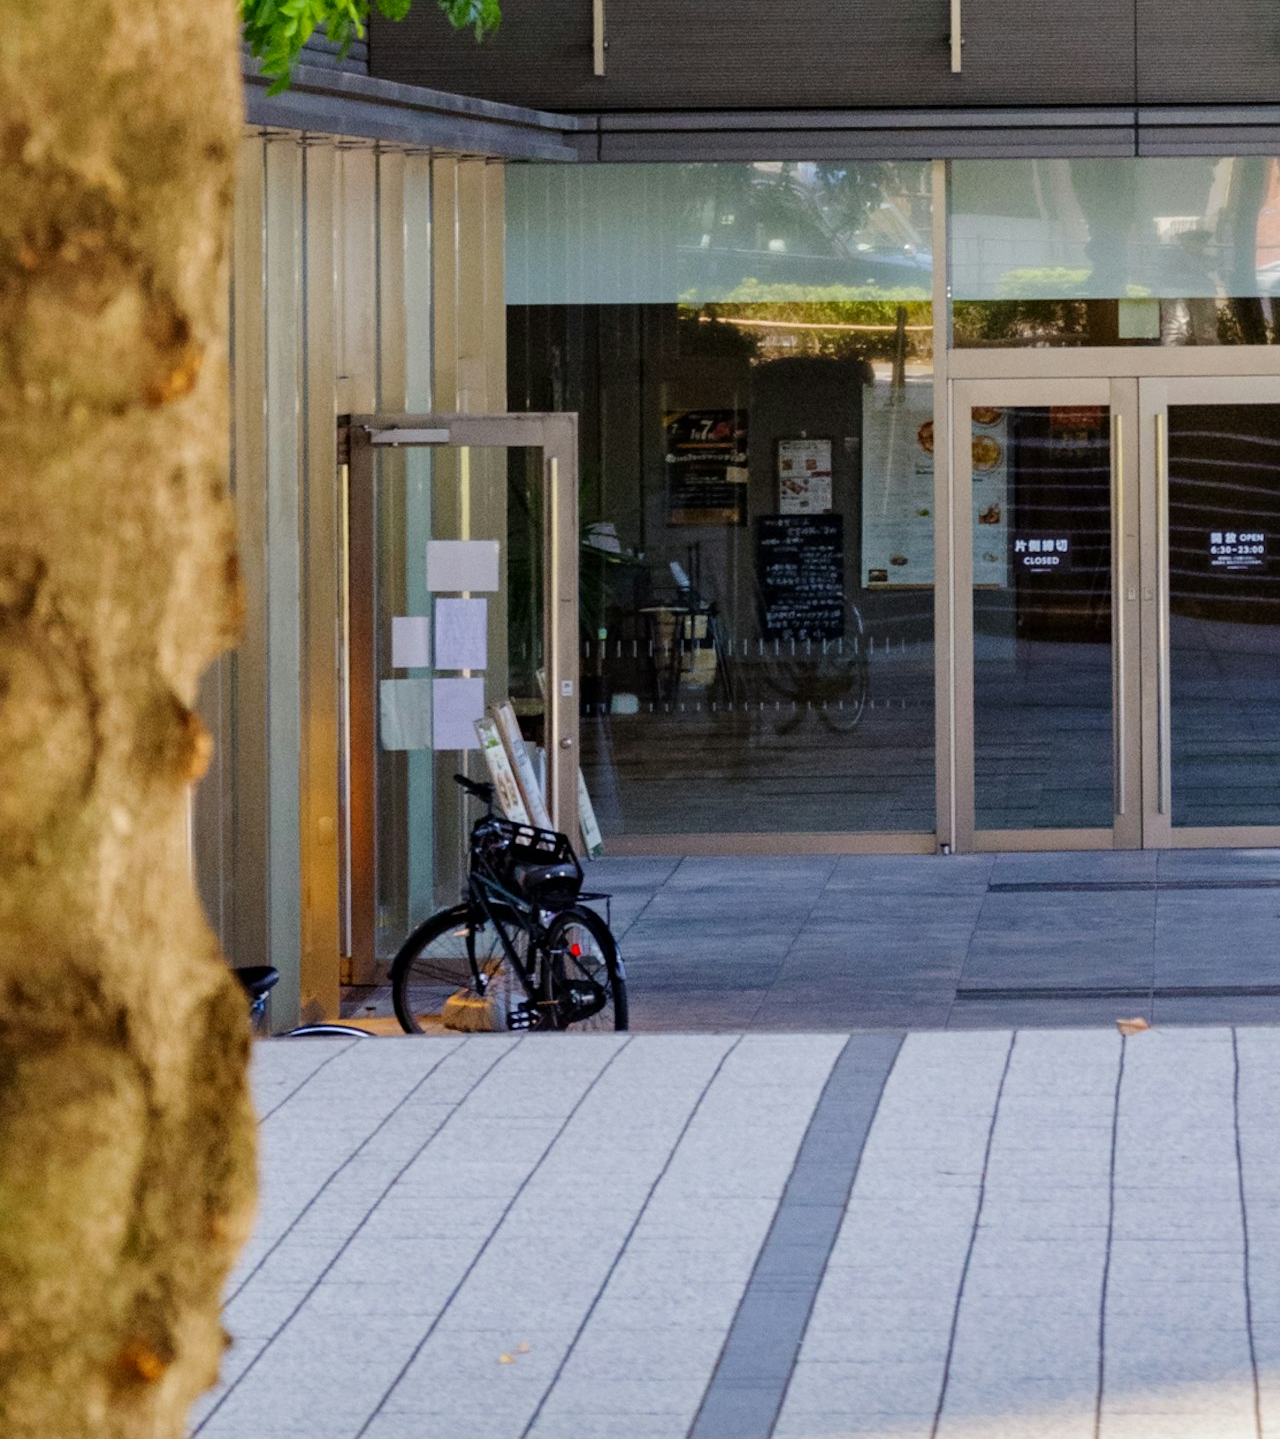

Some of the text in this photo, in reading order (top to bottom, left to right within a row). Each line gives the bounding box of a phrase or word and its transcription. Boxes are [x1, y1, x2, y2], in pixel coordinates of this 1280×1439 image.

[1239, 533, 1265, 542] OPEN
[1014, 539, 1068, 552] 片側締切
[1023, 556, 1060, 565] CLOSED
